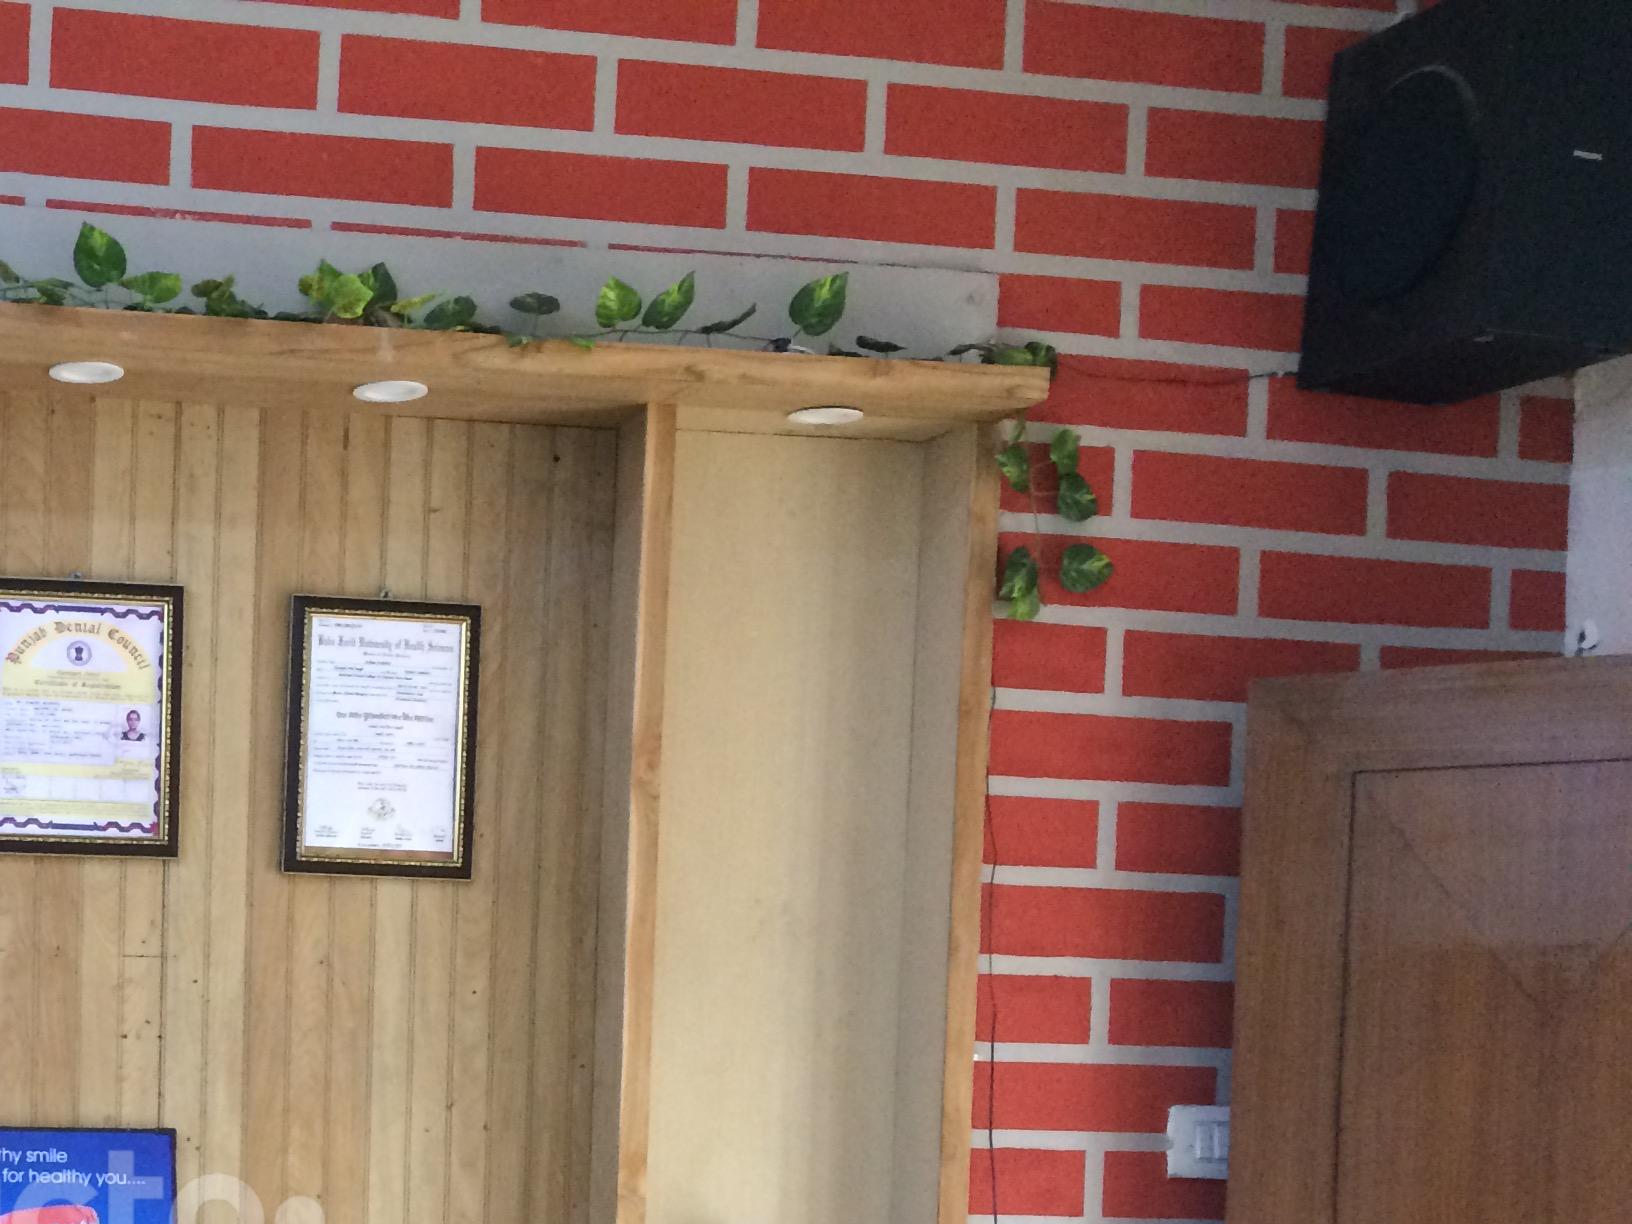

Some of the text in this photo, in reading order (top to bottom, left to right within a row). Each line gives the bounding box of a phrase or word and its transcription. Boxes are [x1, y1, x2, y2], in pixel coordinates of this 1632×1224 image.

[5, 626, 47, 665] Punjab
[107, 628, 151, 670] Council
[26, 1147, 68, 1163] smile
[2, 1167, 24, 1183] for
[28, 1168, 92, 1186] healthy
